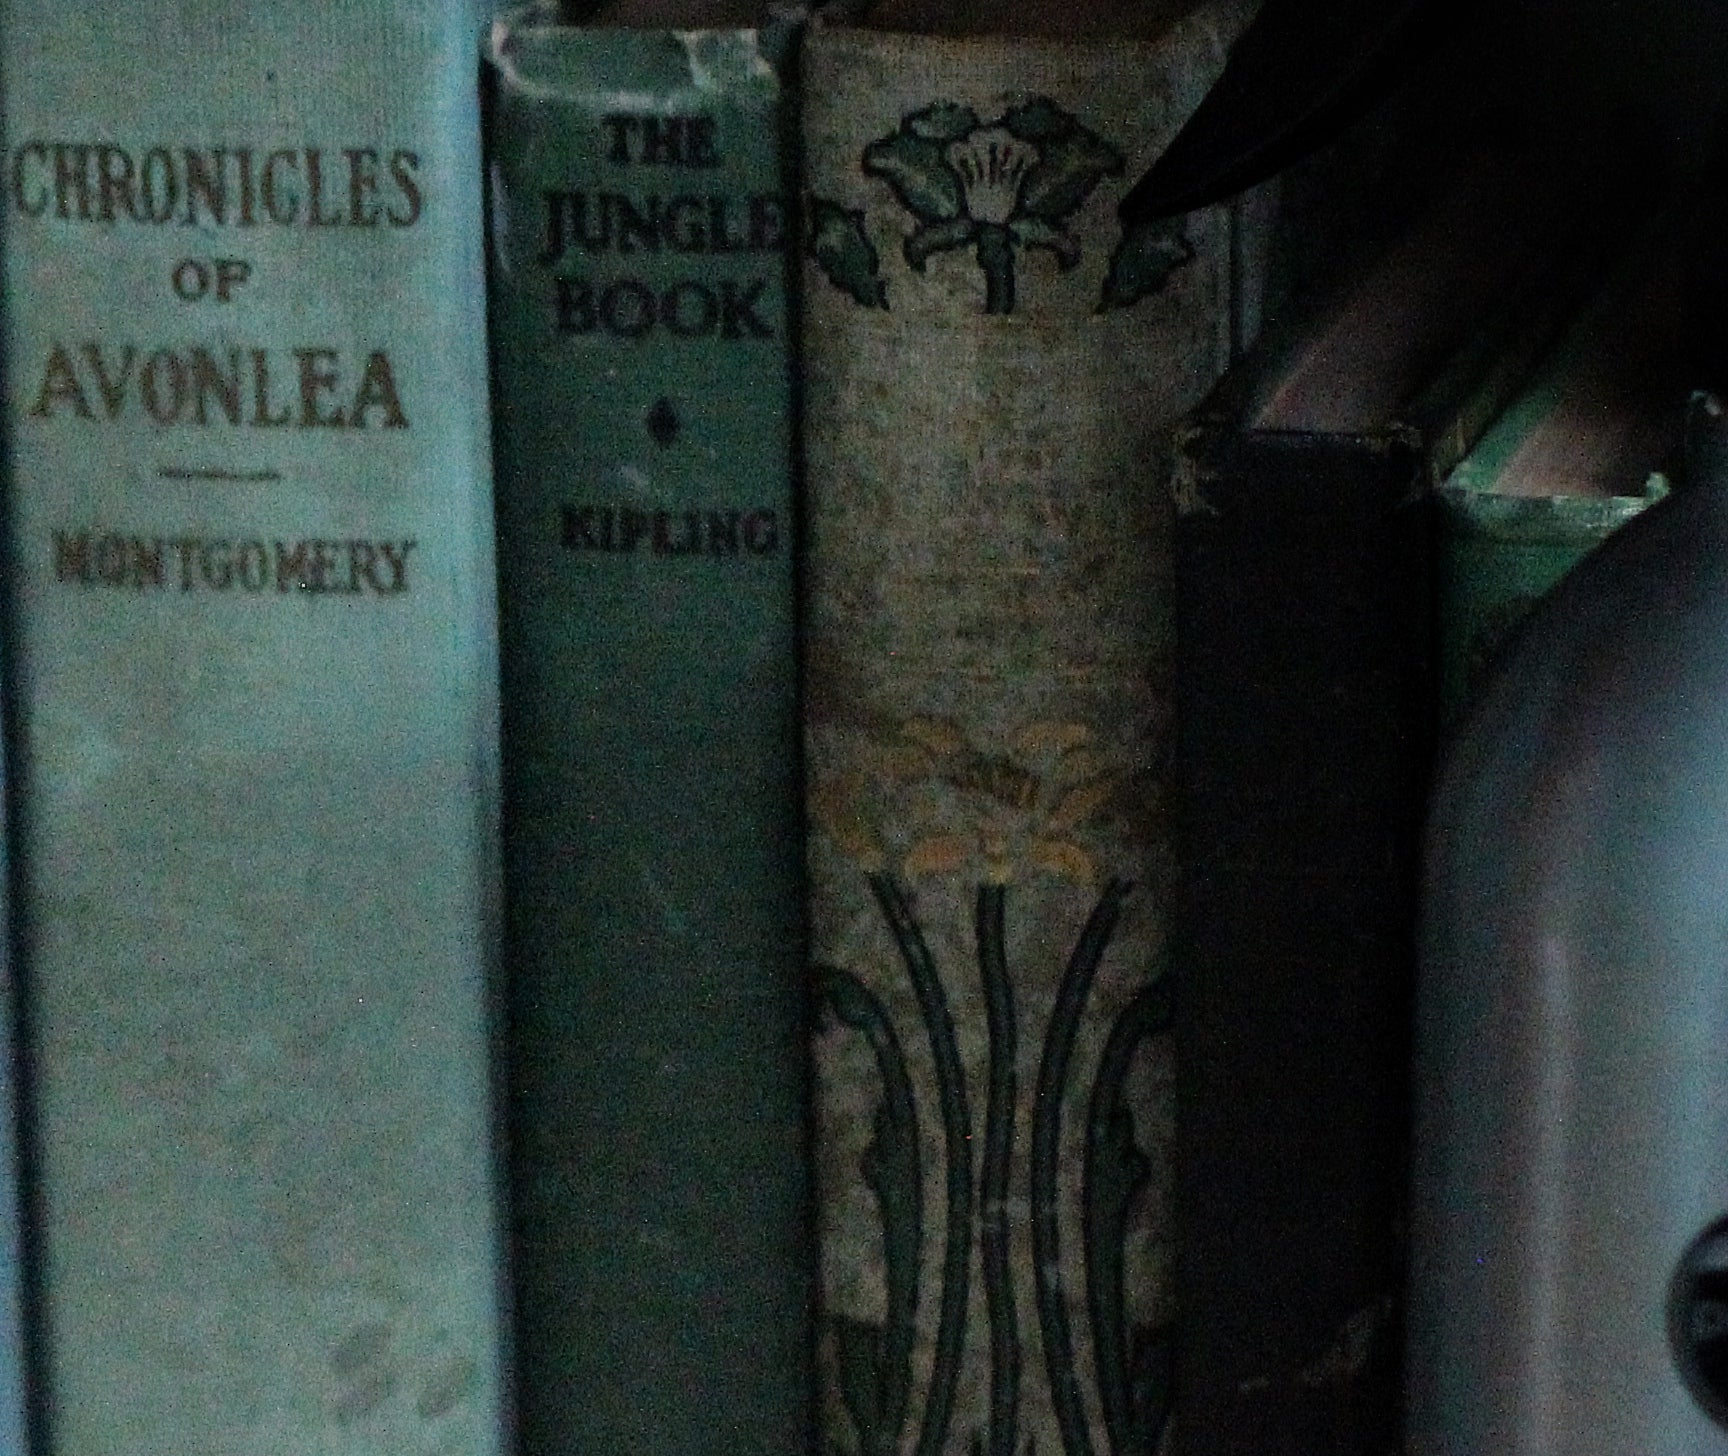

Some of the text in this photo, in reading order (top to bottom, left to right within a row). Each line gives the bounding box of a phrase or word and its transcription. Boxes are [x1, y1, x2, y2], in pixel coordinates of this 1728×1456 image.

[602, 111, 724, 170] THE
[11, 139, 422, 231] CHRONICLES
[538, 191, 788, 268] JUNGLE
[170, 257, 253, 304] OF
[554, 276, 777, 341] BOOK
[32, 345, 410, 430] AVONLEA
[53, 527, 419, 596] MONTGOMERY
[558, 505, 781, 559] KIPLING
